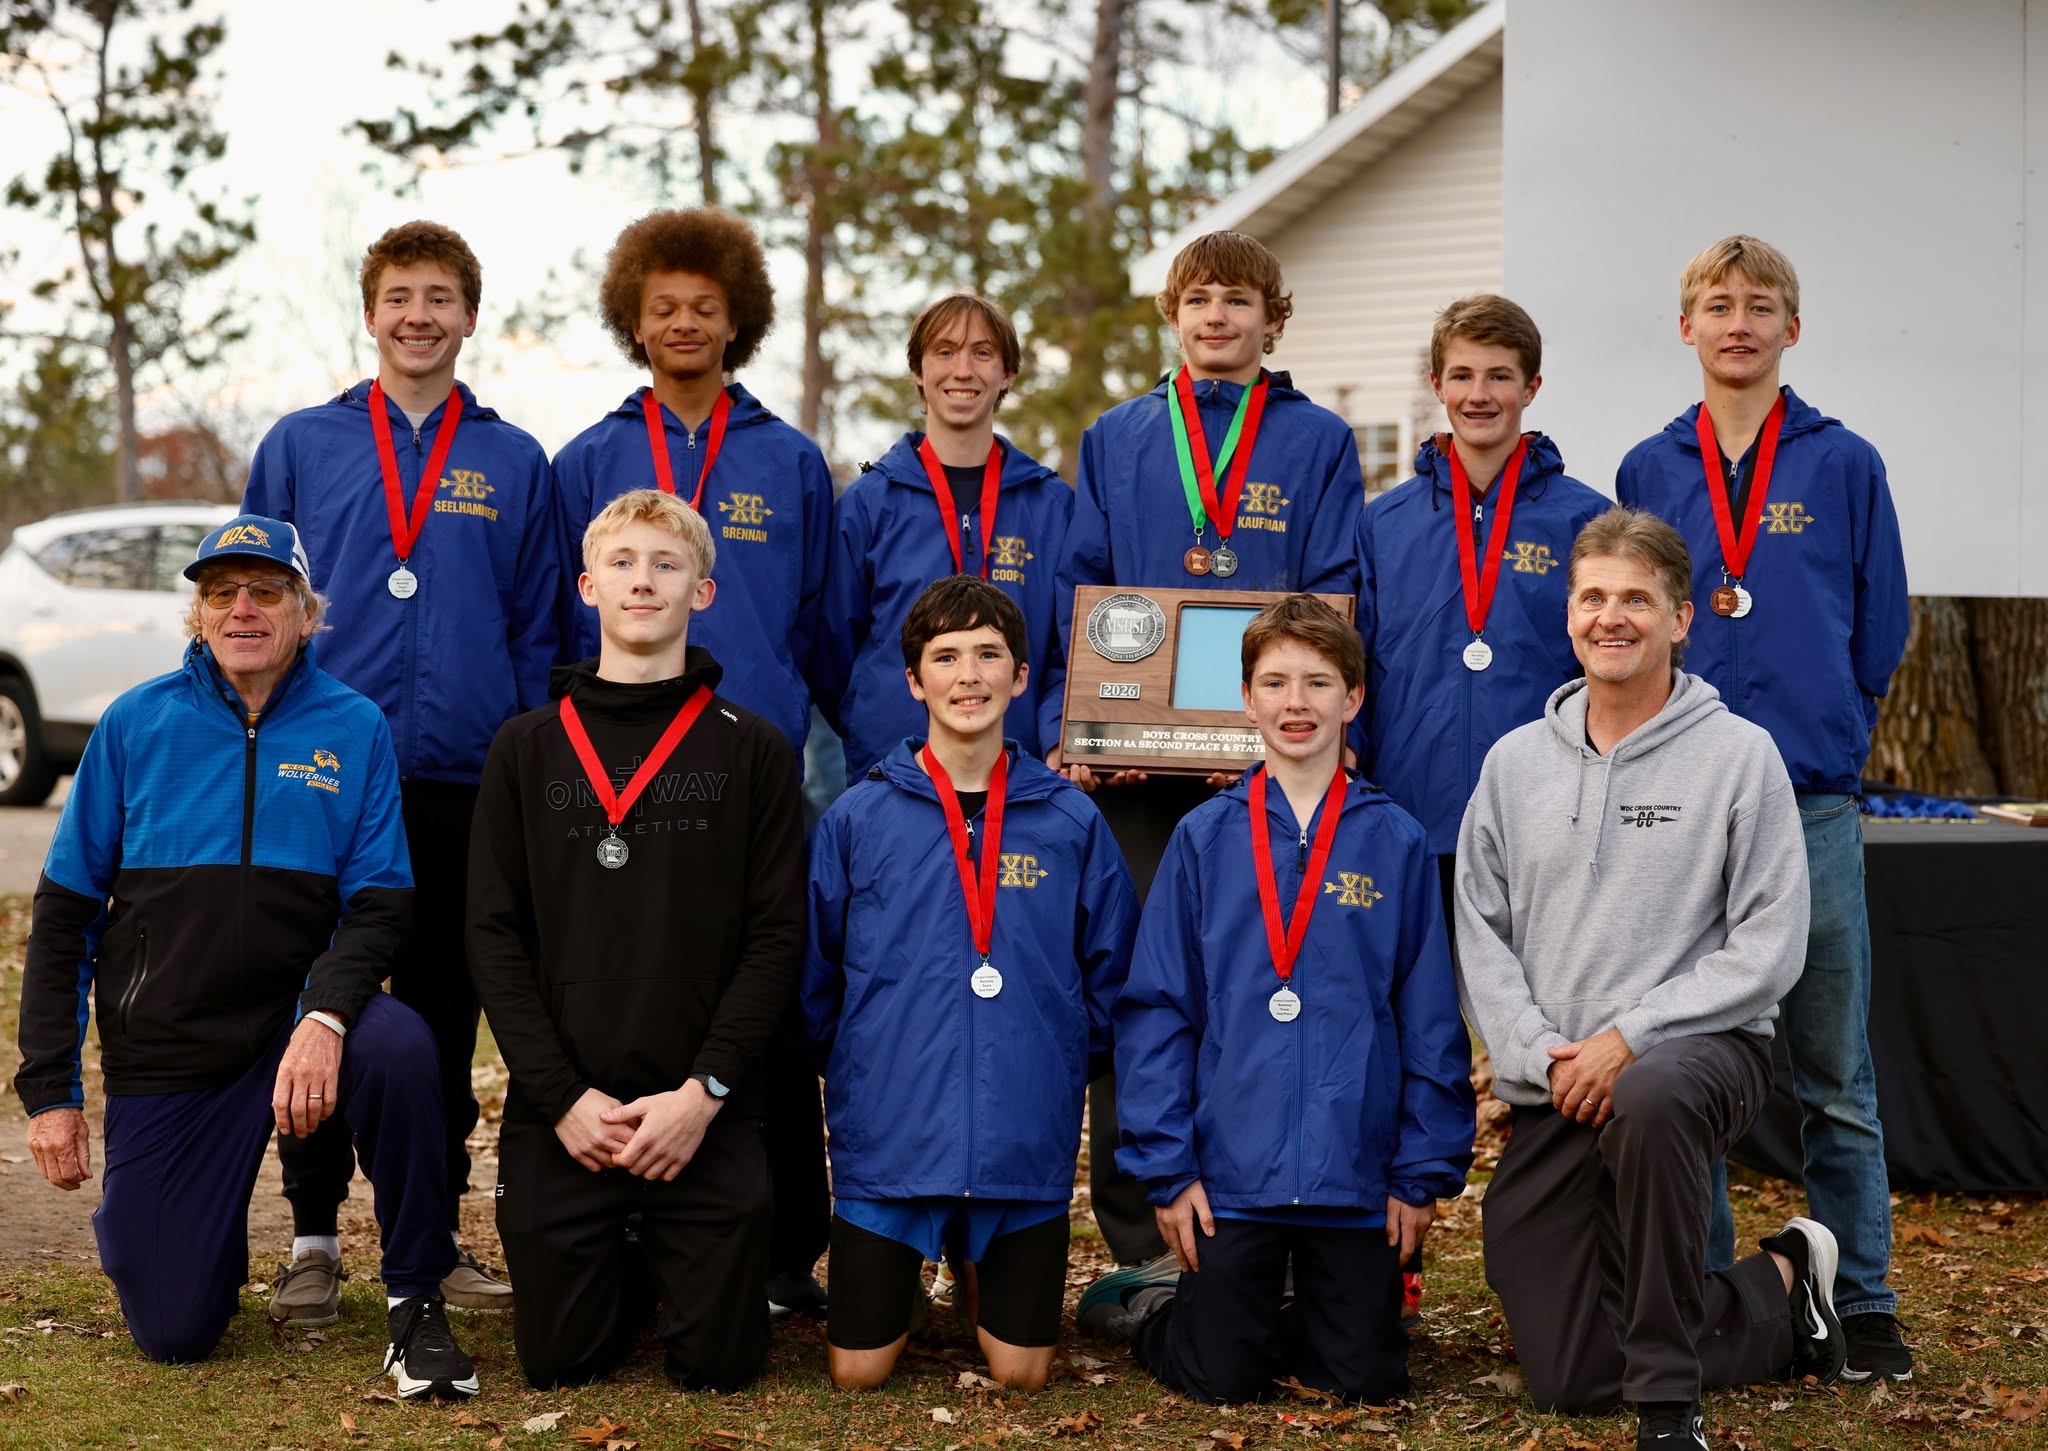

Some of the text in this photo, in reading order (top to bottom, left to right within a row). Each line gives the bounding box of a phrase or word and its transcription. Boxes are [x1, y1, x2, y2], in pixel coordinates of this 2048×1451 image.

[451, 469, 488, 500] XC
[1245, 482, 1281, 515] XC
[729, 492, 765, 525] XC
[1237, 515, 1286, 533] KAUFMAN
[1767, 502, 1805, 534] XC
[722, 526, 768, 543] BRENNAN
[994, 536, 1026, 568] XC
[1513, 541, 1551, 575] XC
[1103, 685, 1136, 696] 2026
[1074, 738, 1122, 748] SECTION
[1138, 741, 1182, 750] SECOND
[1185, 742, 1220, 751] PLACE
[1142, 731, 1262, 743] BOYS CROSS COUNTRY
[277, 769, 340, 787] WOLVERINES
[650, 771, 729, 804] WAY
[567, 819, 709, 838] ATHLETICS
[1636, 811, 1655, 828] CC
[999, 853, 1038, 888] XC
[1337, 871, 1374, 909] XC
